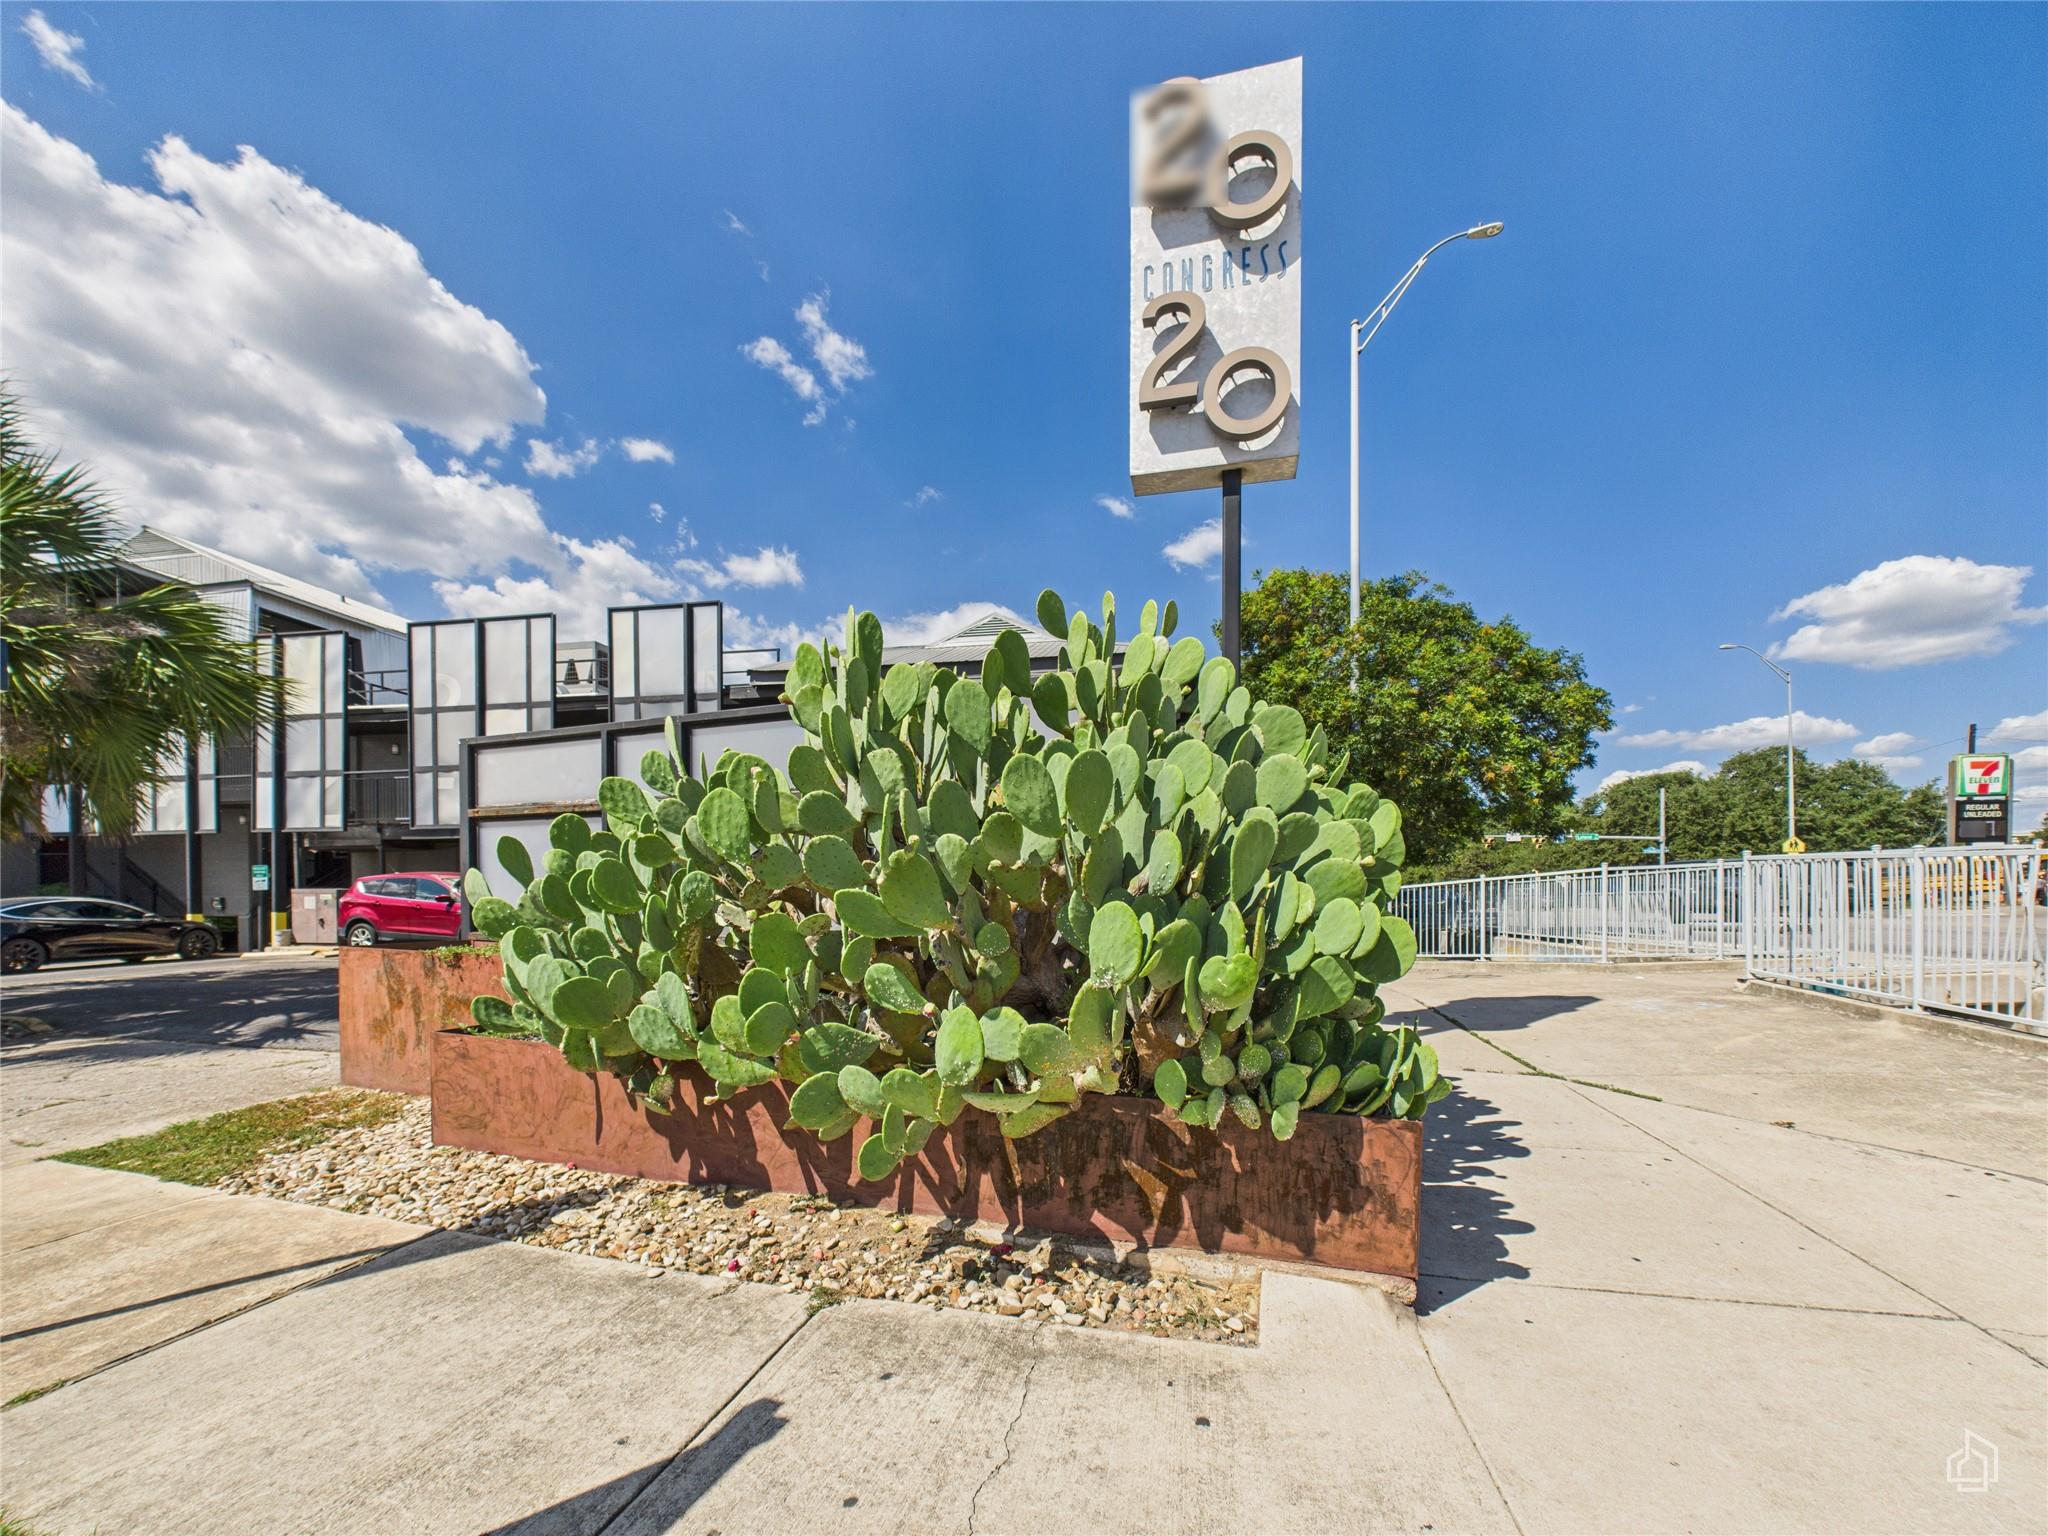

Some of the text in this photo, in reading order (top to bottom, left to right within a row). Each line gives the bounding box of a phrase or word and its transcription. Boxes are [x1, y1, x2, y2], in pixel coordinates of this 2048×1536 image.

[1143, 240, 1288, 301] CONGRESS
[1139, 290, 1292, 442] 20
[1970, 761, 2000, 794] 7
